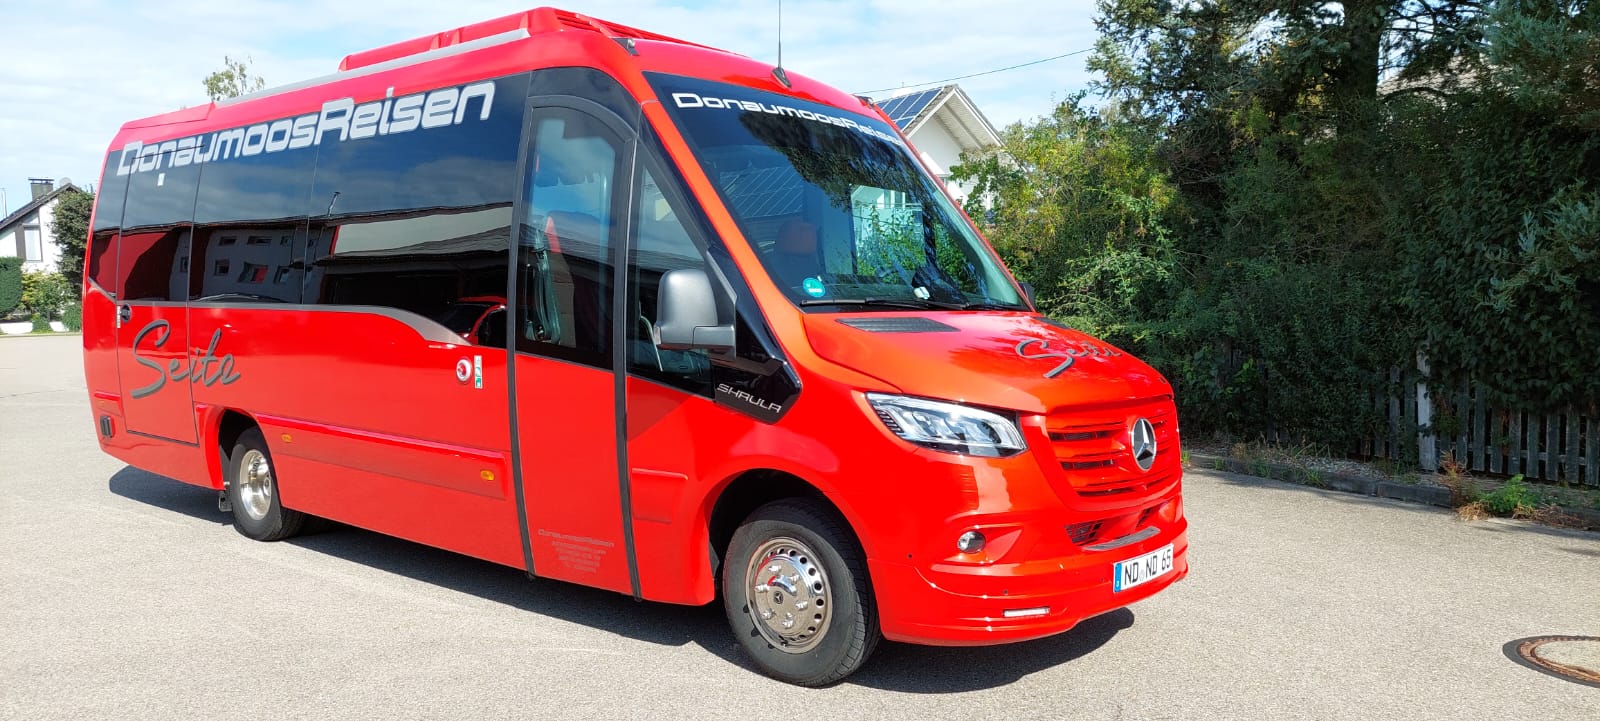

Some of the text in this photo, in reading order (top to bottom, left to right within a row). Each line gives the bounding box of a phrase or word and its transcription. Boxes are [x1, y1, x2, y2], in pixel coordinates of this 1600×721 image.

[116, 80, 496, 176] DonaumoosReisen
[716, 383, 782, 414] SHAULA
[1124, 548, 1172, 585] ND ND 65
